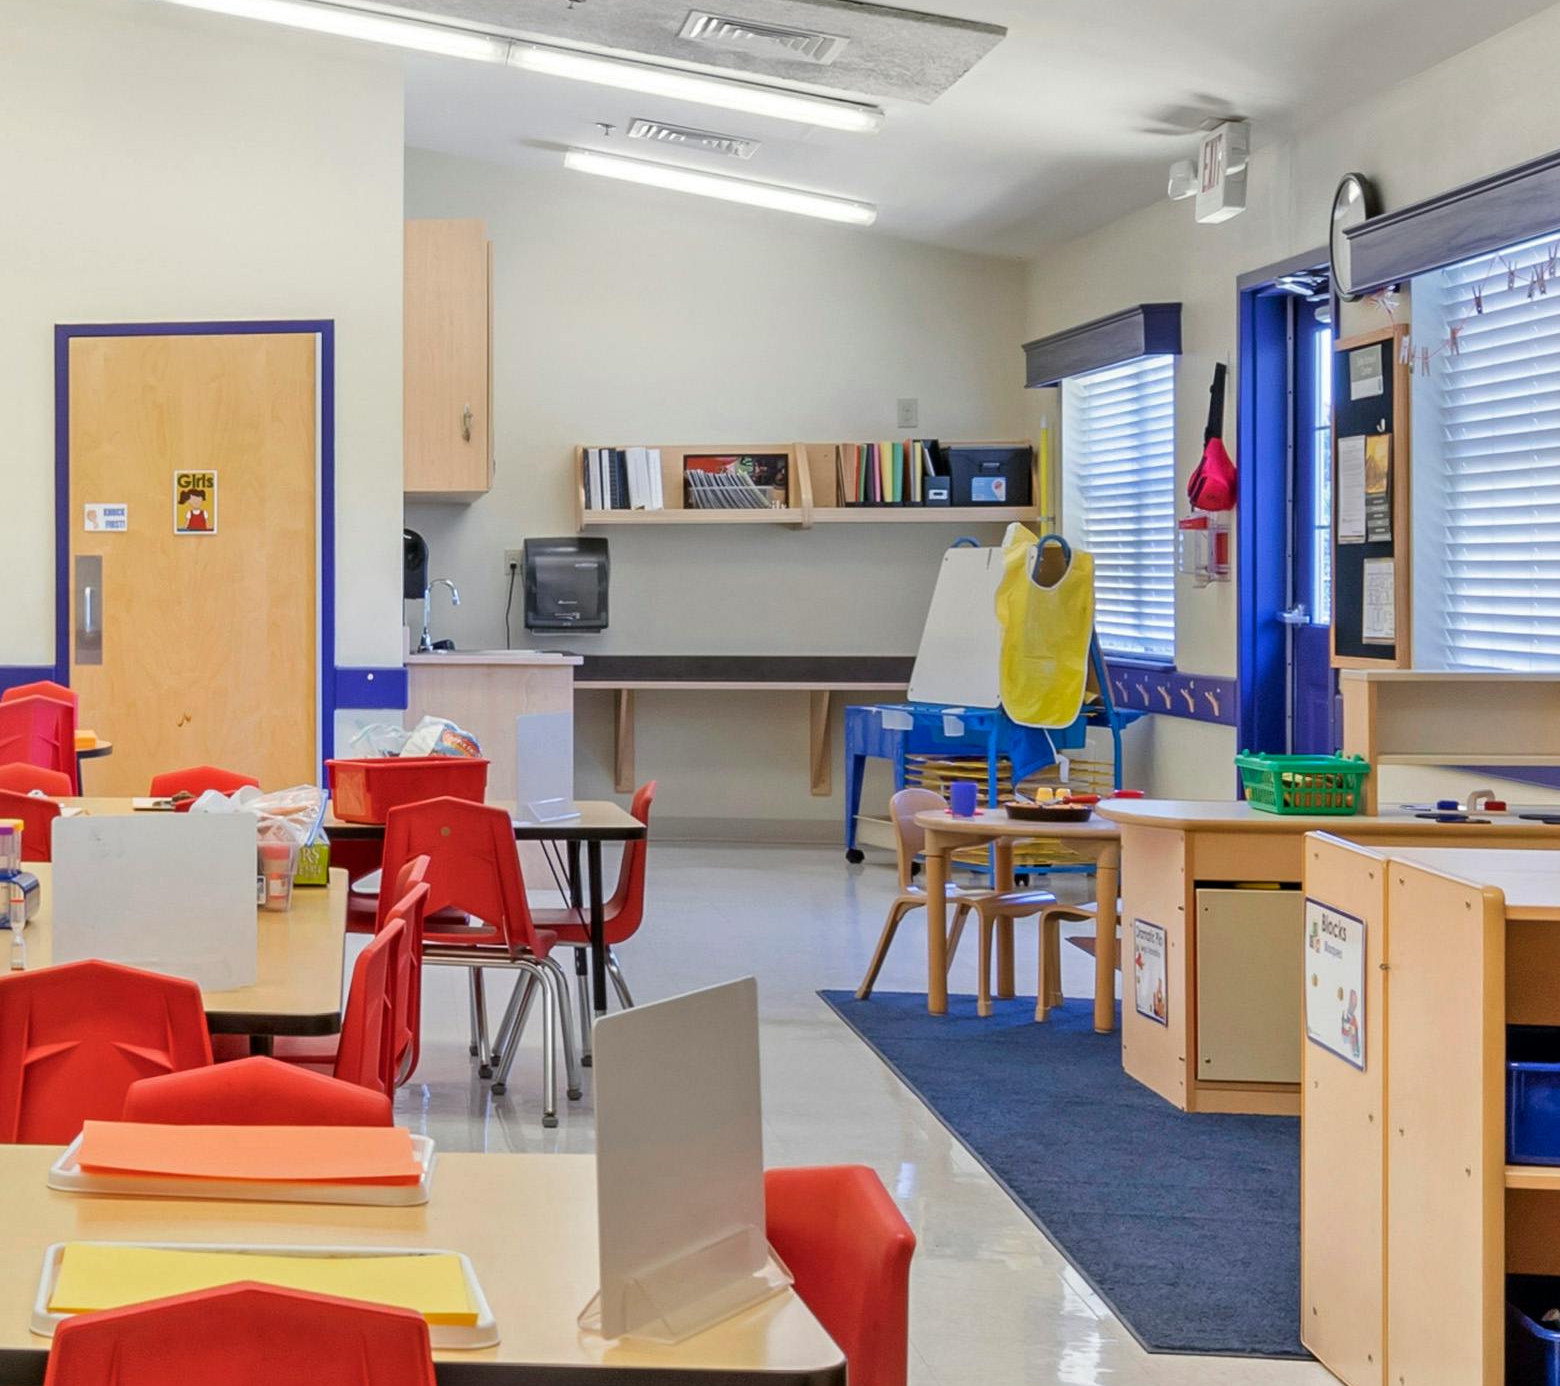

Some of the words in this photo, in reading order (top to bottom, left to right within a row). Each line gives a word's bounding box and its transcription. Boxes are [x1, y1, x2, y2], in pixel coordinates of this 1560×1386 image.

[1201, 133, 1223, 194] EXIT
[177, 473, 214, 489] Girls
[1321, 913, 1347, 941] Blocks
